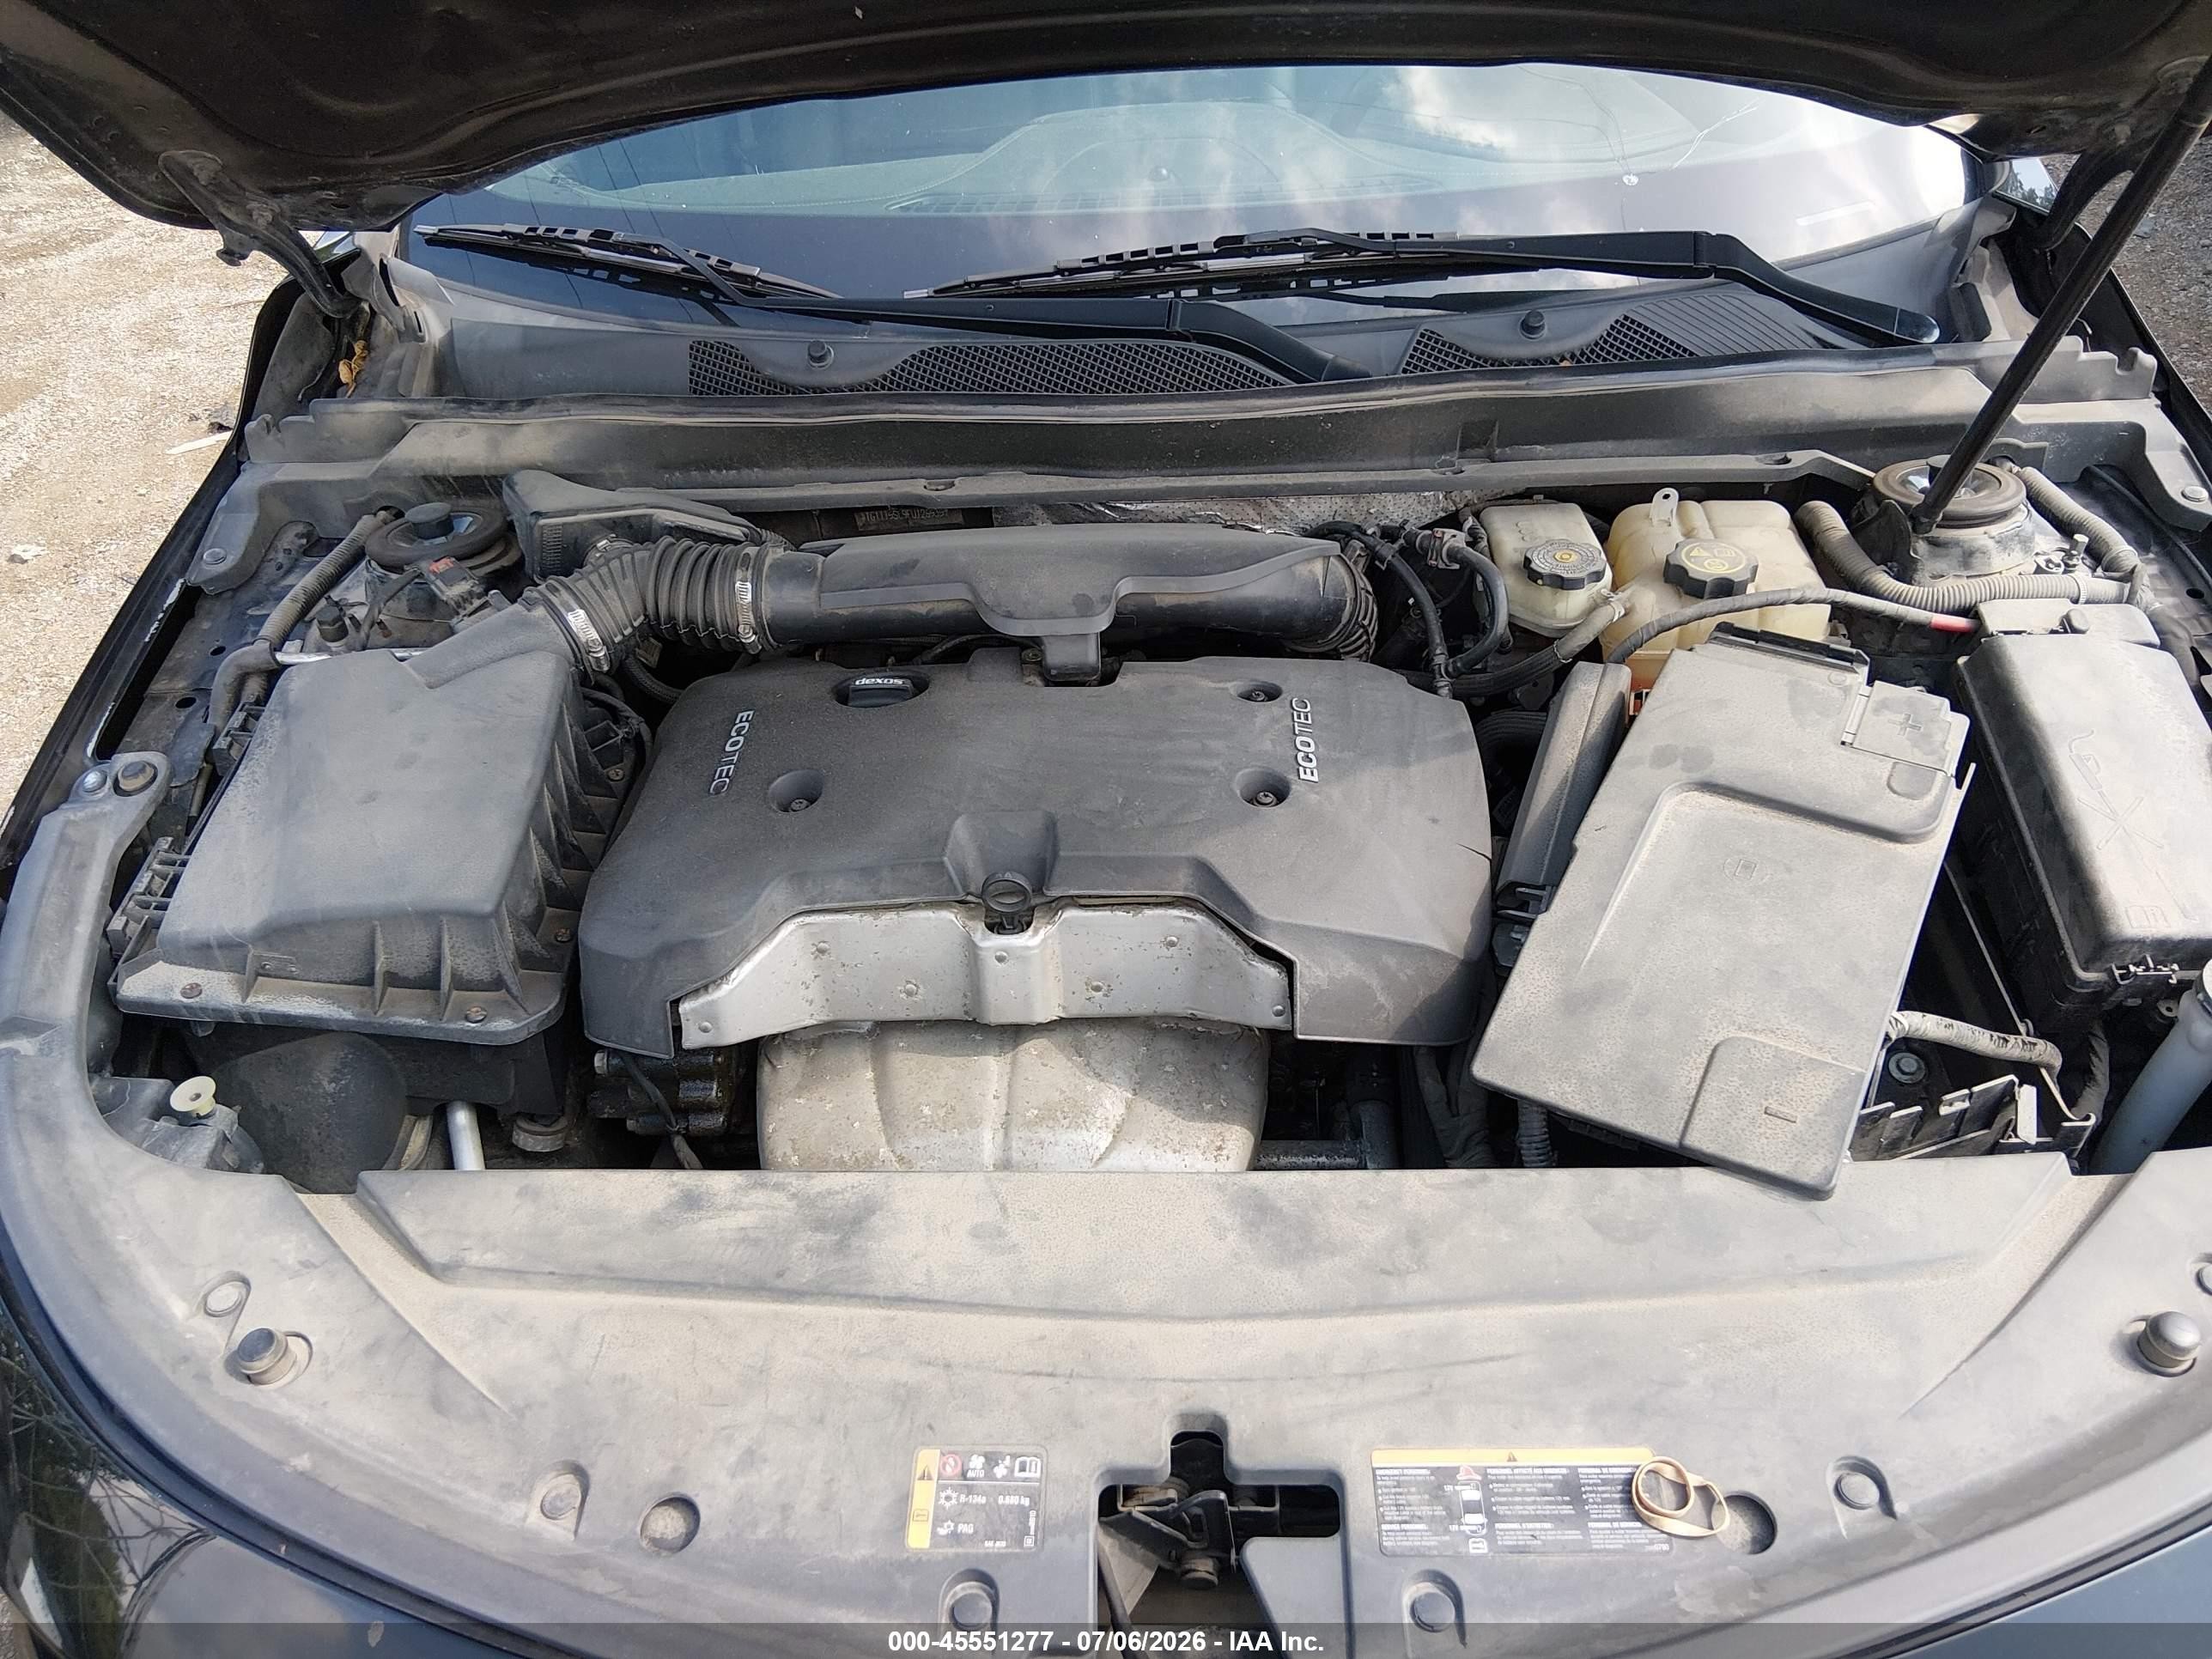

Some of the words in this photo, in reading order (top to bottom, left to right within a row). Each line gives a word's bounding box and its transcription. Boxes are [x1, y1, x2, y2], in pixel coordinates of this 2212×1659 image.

[1291, 697, 1319, 783] ECOTEC
[709, 710, 756, 793] ECOTEC
[967, 1469, 985, 1478] AUTO
[959, 1494, 987, 1504] R-134a
[1020, 1495, 1030, 1507] kg
[957, 1523, 974, 1534] PAG
